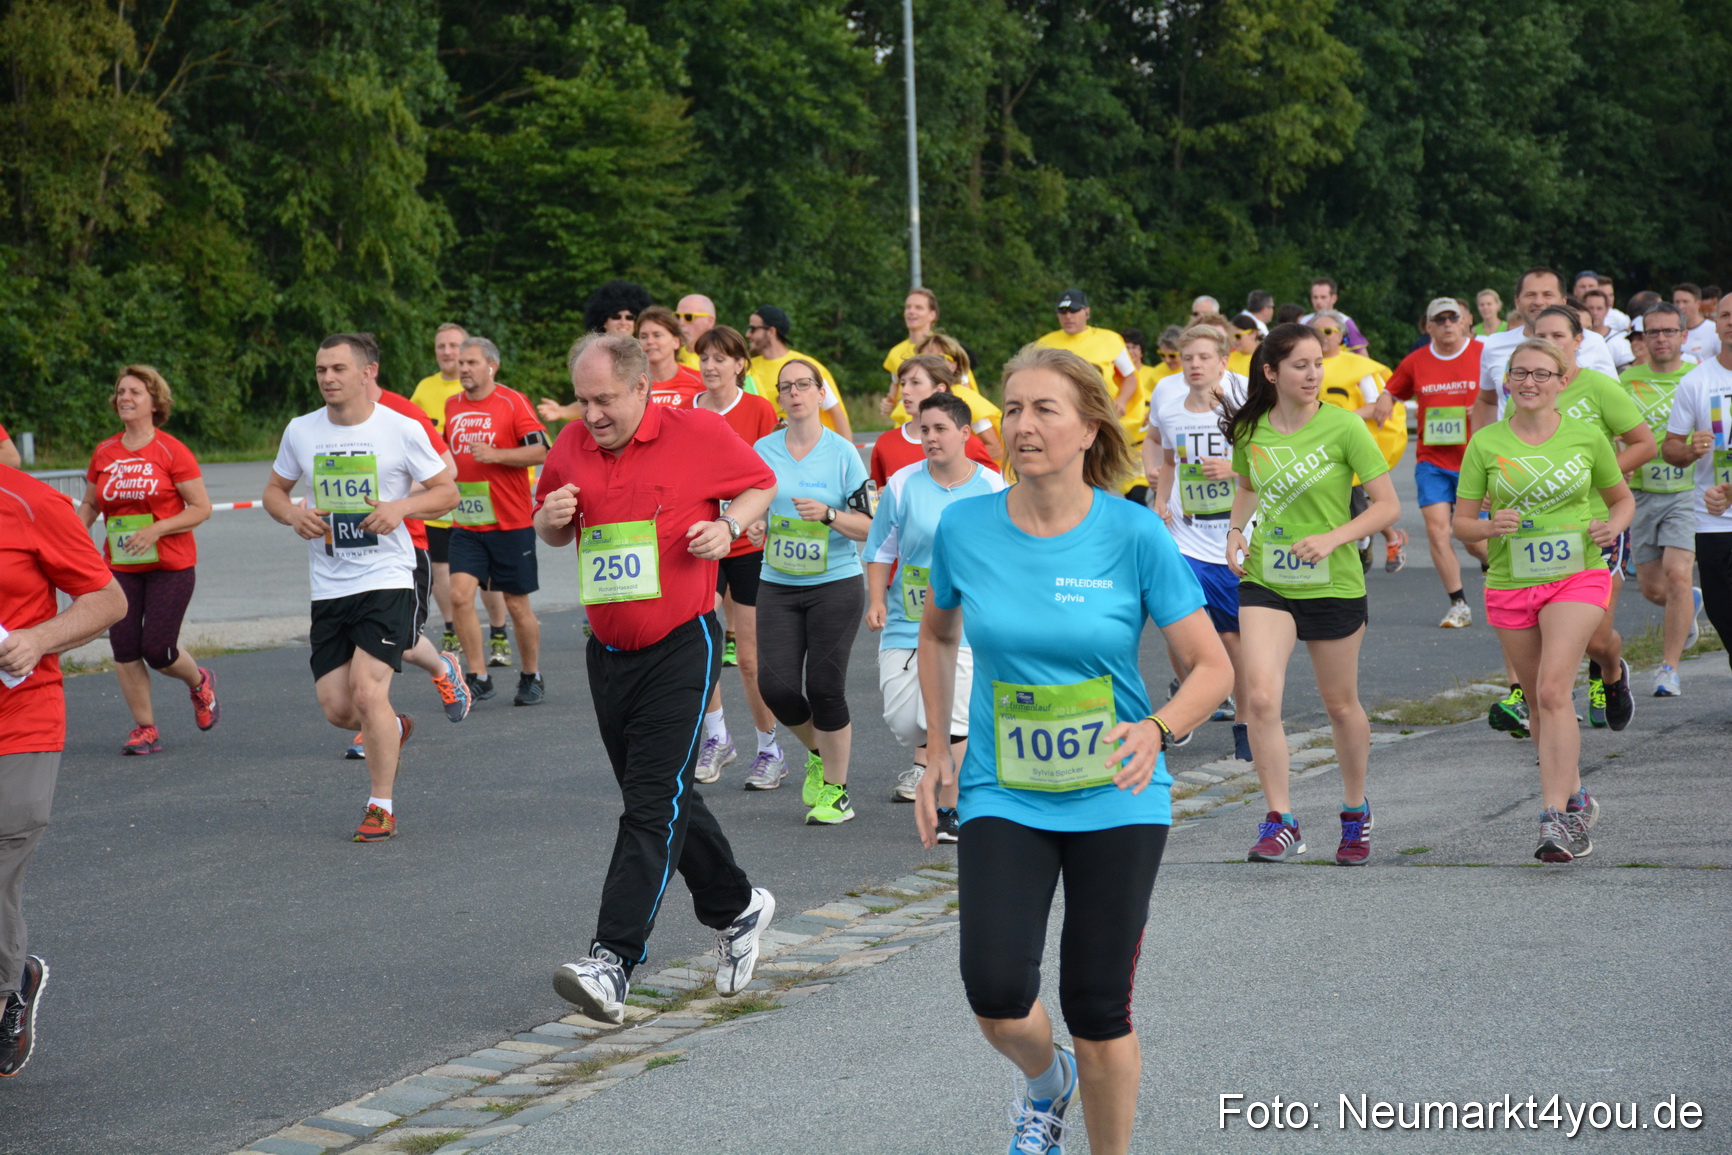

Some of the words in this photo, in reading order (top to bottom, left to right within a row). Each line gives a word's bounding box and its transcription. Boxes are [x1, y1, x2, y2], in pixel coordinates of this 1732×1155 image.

[1422, 381, 1467, 393] NEUMARKT
[672, 394, 682, 405] &
[450, 411, 484, 431] Town
[482, 417, 492, 429] &
[1429, 421, 1460, 434] 1401
[450, 428, 496, 455] Country
[103, 457, 145, 477] Town
[142, 463, 153, 475] &
[1651, 466, 1685, 481] 219
[103, 474, 158, 501] Country
[320, 478, 371, 498] 1164
[1259, 444, 1330, 514] RKHARDT
[119, 491, 146, 500] HAUS
[1185, 481, 1230, 500] 1163
[457, 499, 484, 514] 426
[337, 522, 364, 540] RW
[336, 549, 379, 558] RAUMWERK
[773, 538, 821, 561] 1503
[1524, 539, 1571, 563] 193
[592, 553, 641, 582] 250
[1065, 578, 1113, 589] PFLEIDERER
[908, 588, 926, 606] 15
[1055, 592, 1084, 603] Sylvia
[1008, 720, 1104, 761] 1067
[1032, 767, 1055, 778] Sylvia
[1055, 766, 1084, 778] Spicker
